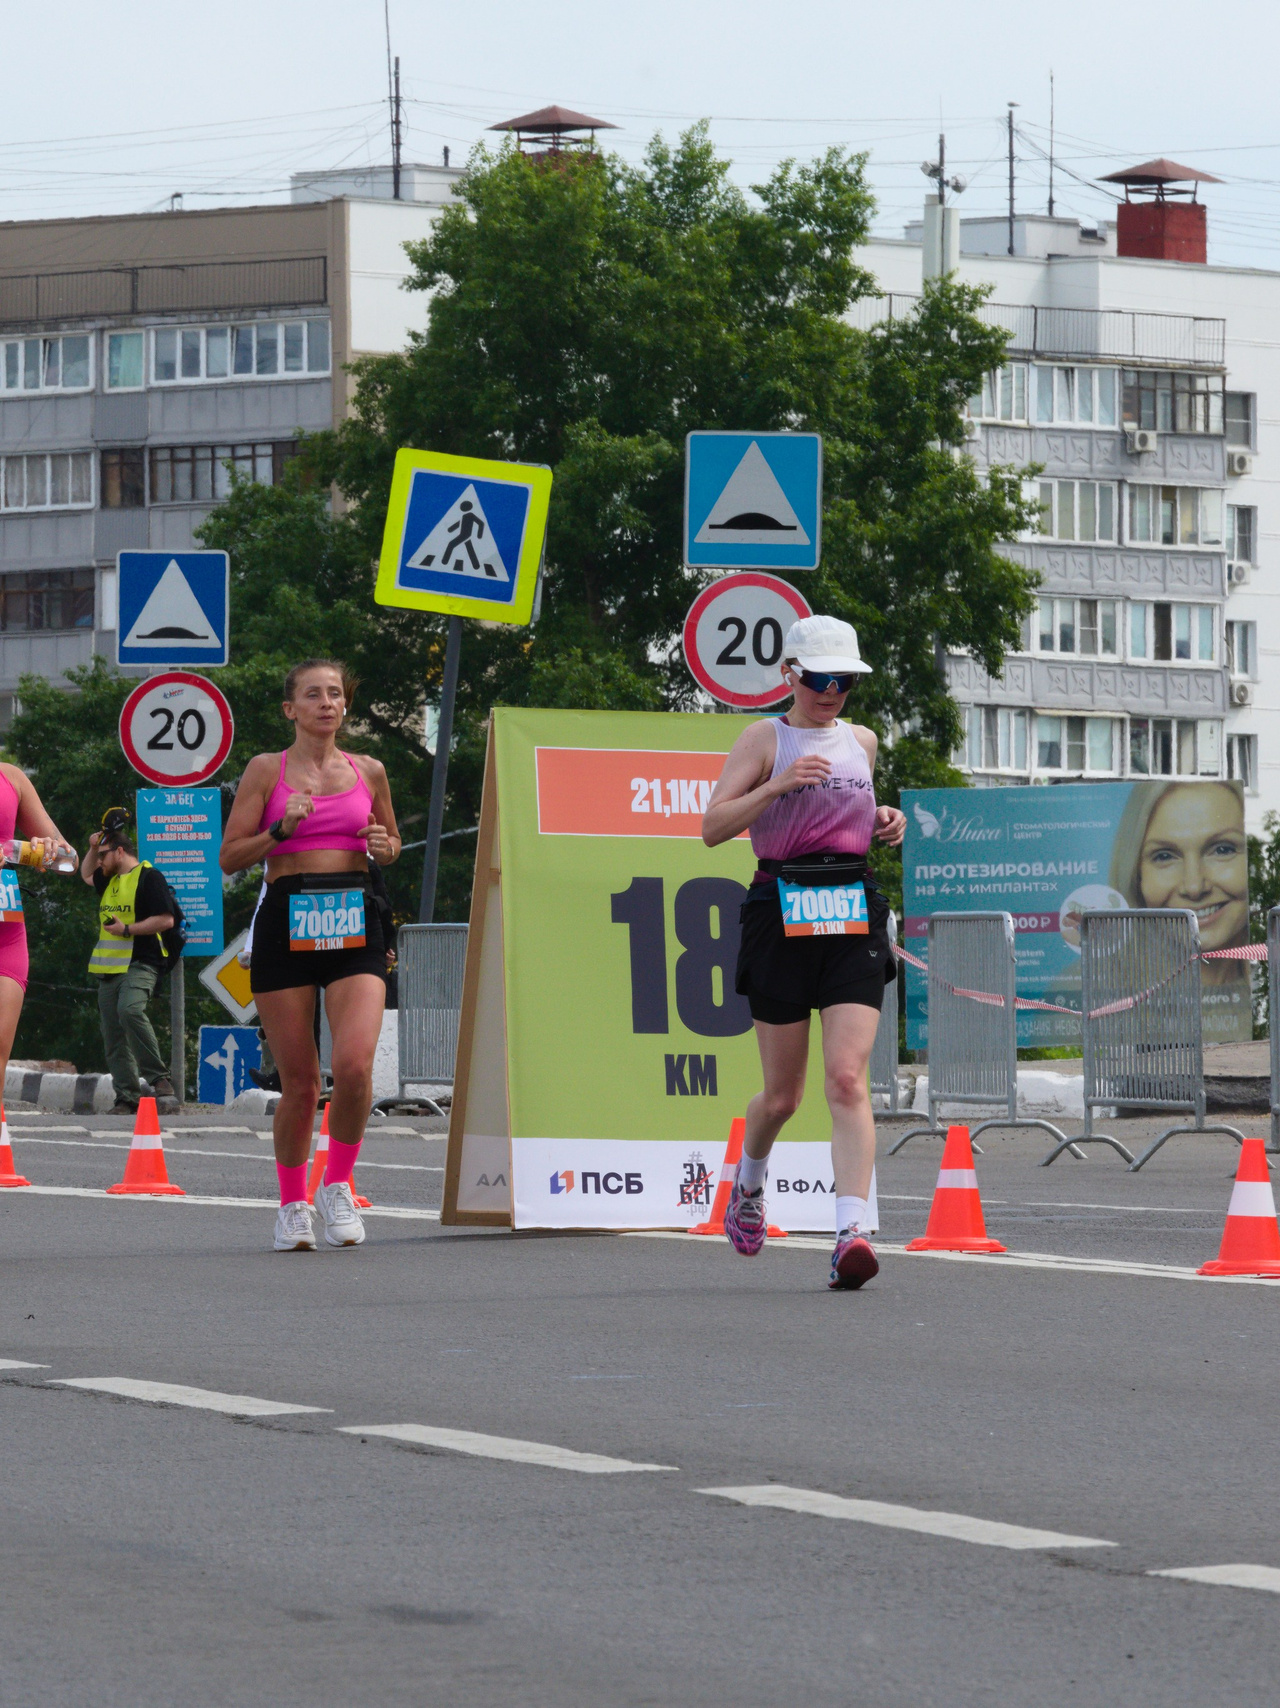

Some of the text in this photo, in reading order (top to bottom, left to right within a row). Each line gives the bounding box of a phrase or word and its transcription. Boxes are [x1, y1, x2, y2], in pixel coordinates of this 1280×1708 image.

[715, 616, 783, 666] 20
[147, 707, 206, 751] 20
[915, 861, 1098, 879] ПРОТЕЗИРОВАНИЕ
[915, 882, 1058, 895] на 4-х имплантах
[786, 889, 860, 921] 70067
[294, 907, 361, 937] 70020
[812, 921, 846, 935] 21.1КМ
[315, 937, 344, 950] 21.1КМ
[611, 877, 754, 1037] 18
[664, 1054, 718, 1096] КМ
[581, 1171, 644, 1195] ПСБ
[683, 1163, 709, 1184] ЗА
[680, 1184, 714, 1205] БЕГ
